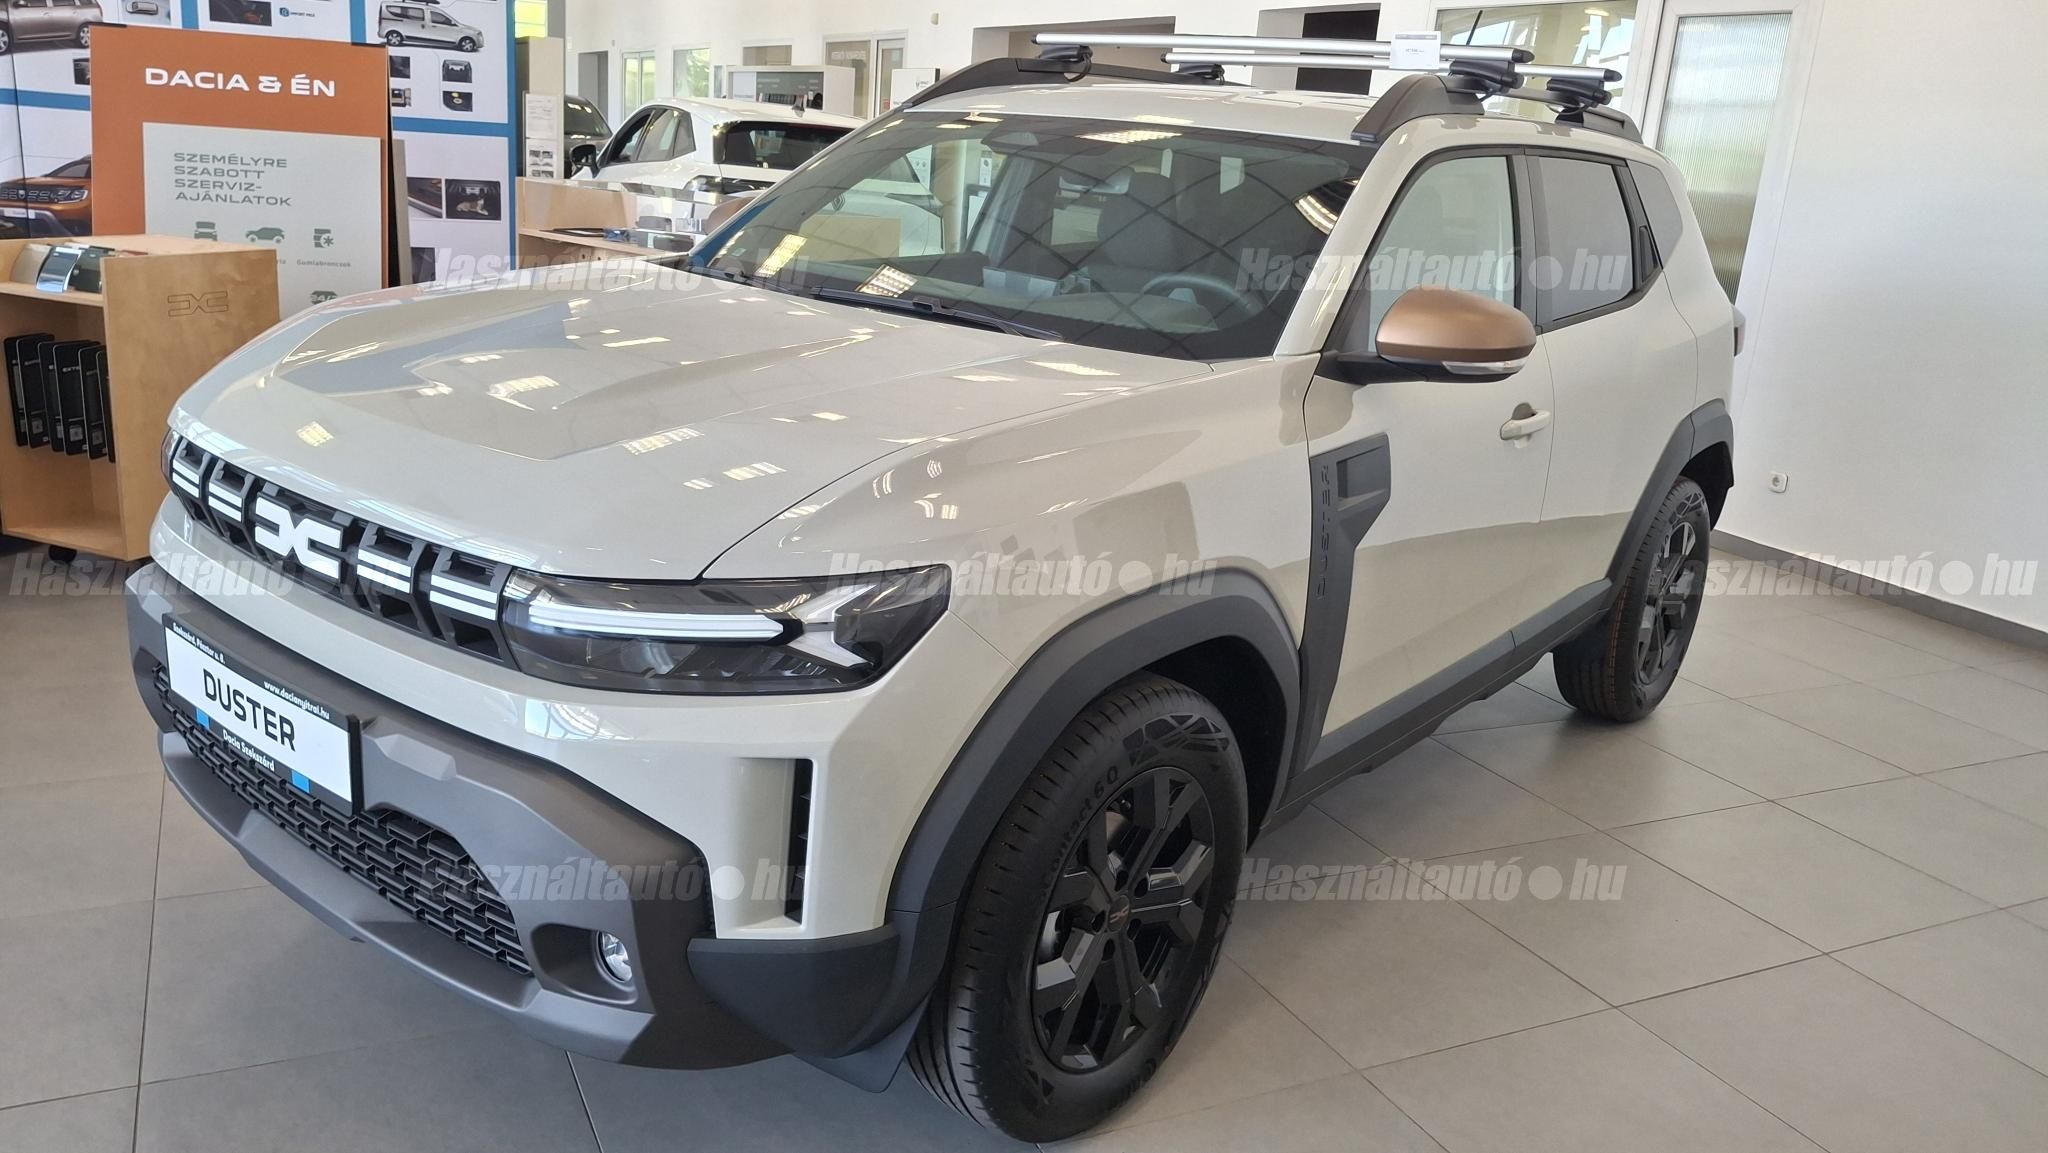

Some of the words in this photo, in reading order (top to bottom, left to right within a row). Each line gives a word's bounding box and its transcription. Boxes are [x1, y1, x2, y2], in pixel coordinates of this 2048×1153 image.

[145, 67, 250, 92] DACIA
[258, 75, 282, 93] &
[290, 74, 336, 97] ÉN
[173, 152, 288, 168] SZEMÉLYRE
[173, 165, 265, 179] SZABOTT
[174, 178, 263, 192] SZERVIZ-
[175, 190, 292, 206] AJÁNLATOK
[203, 668, 297, 752] DUSTER
[222, 728, 241, 750] Dacia
[241, 741, 275, 772] Szekszárd
